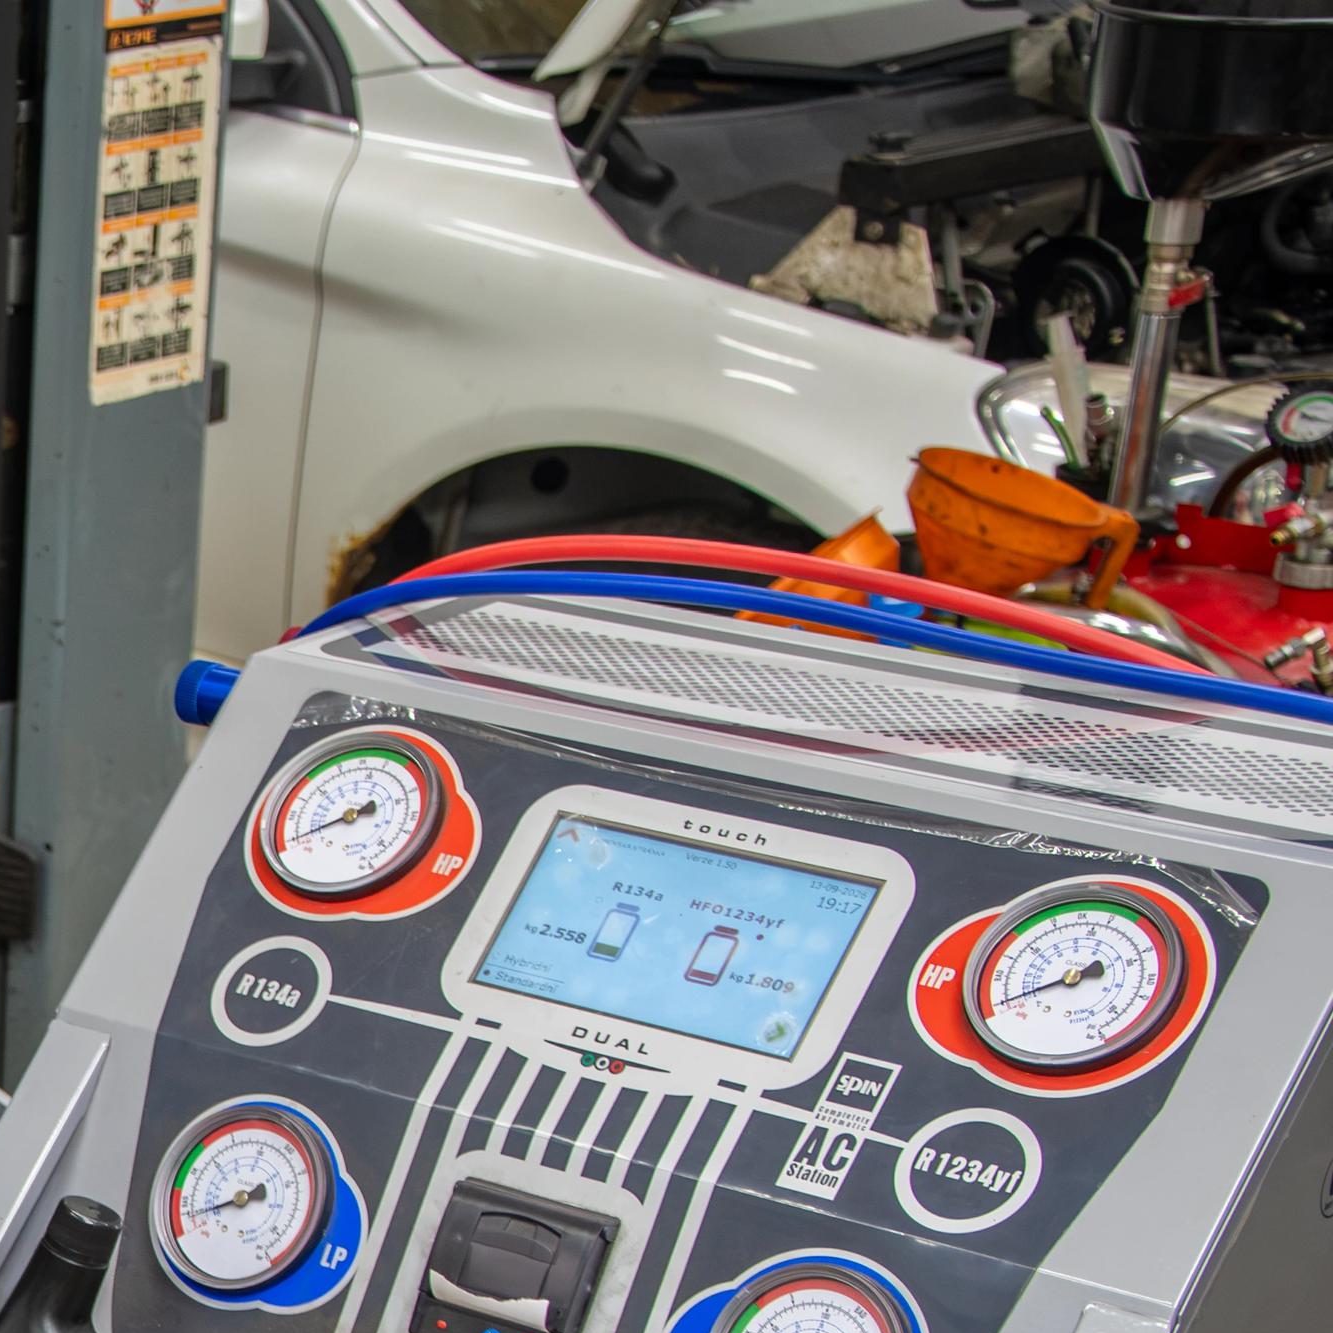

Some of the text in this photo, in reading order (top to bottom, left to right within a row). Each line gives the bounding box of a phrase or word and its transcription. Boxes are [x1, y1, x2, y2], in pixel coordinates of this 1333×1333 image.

[683, 819, 767, 846] touch
[432, 853, 464, 877] HP
[612, 881, 665, 903] R134a
[689, 899, 786, 929] HFO1234yf
[816, 896, 862, 914] 19:17
[539, 923, 587, 944] 2.558
[744, 973, 795, 993] 1.809
[919, 963, 956, 990] HP
[571, 1026, 650, 1055] DUAL
[815, 1113, 867, 1132] Automatic
[818, 1105, 871, 1125] Completely
[793, 1125, 857, 1172] AC
[786, 1162, 838, 1188] Station
[320, 1243, 348, 1270] LP
